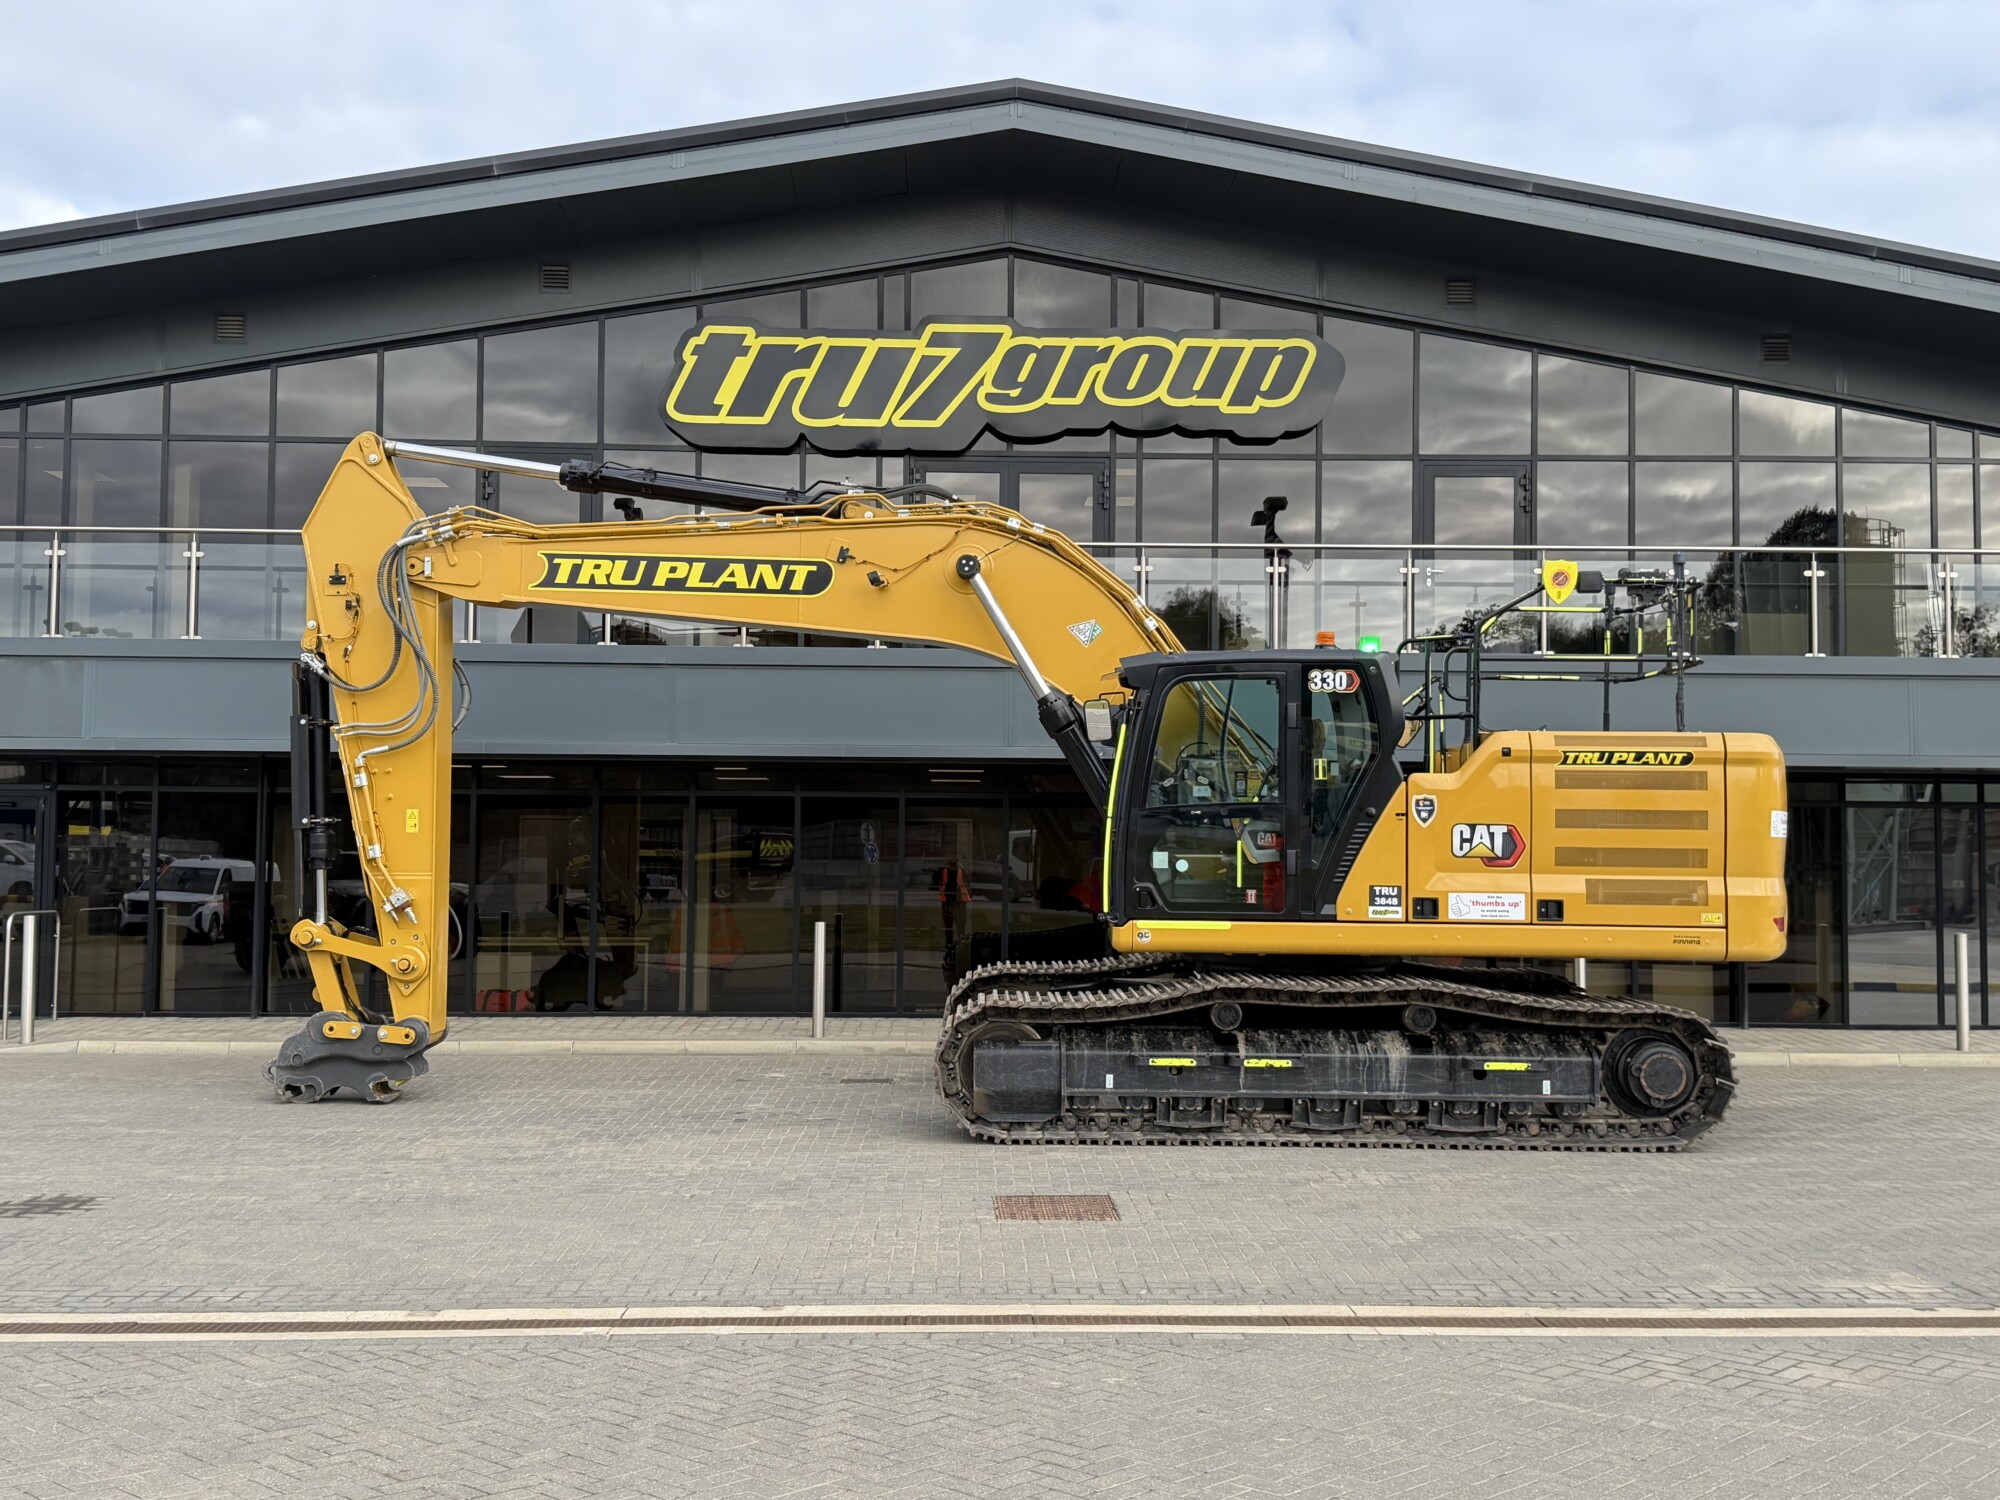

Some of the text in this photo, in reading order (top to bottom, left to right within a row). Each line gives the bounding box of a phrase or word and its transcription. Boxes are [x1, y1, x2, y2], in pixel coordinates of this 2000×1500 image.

[552, 558, 817, 590] TRU PLANT
[1310, 671, 1347, 690] 330
[1565, 752, 1687, 765] TRU PLANT
[1452, 823, 1508, 858] CAT
[1373, 886, 1398, 896] TRU
[1374, 897, 1399, 905] 3848
